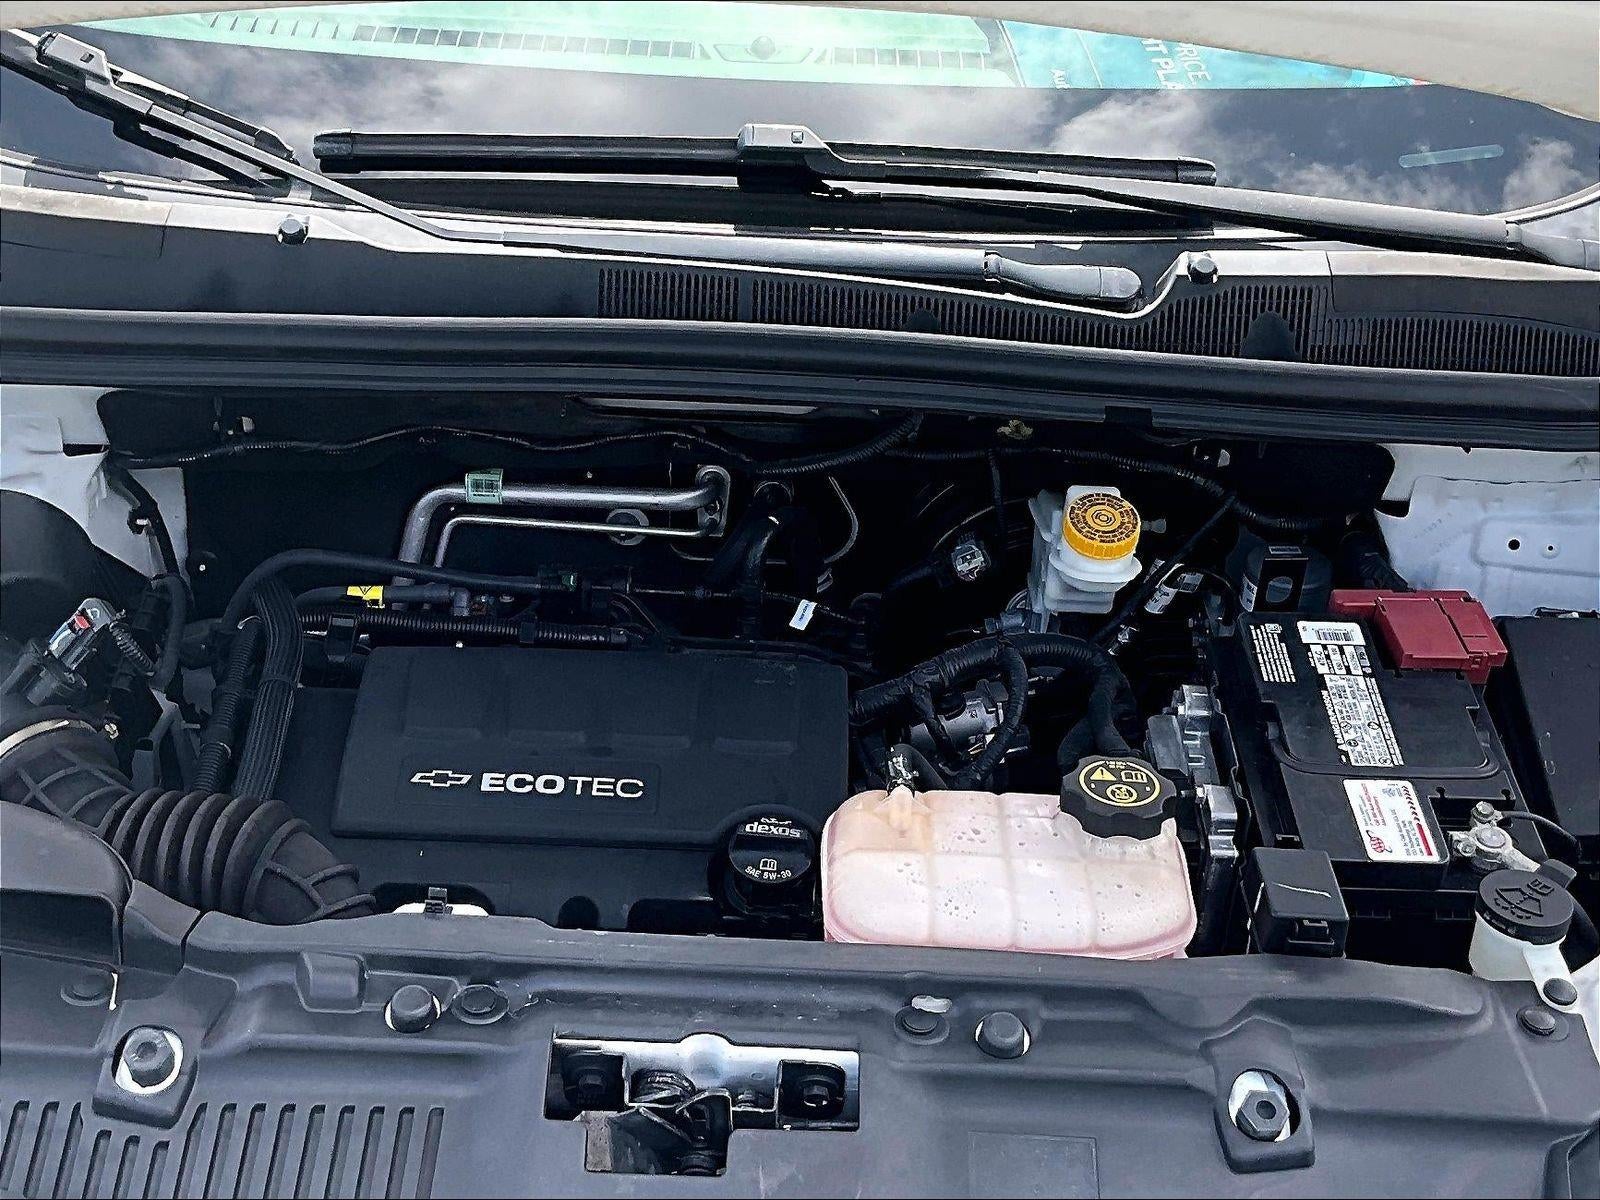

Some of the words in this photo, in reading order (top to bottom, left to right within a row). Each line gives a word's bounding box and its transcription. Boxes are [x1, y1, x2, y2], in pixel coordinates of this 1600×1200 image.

[480, 772, 644, 798] ECOTEC
[745, 821, 804, 838] dexos
[744, 865, 761, 878] SAE
[762, 869, 792, 880] 5W-30
